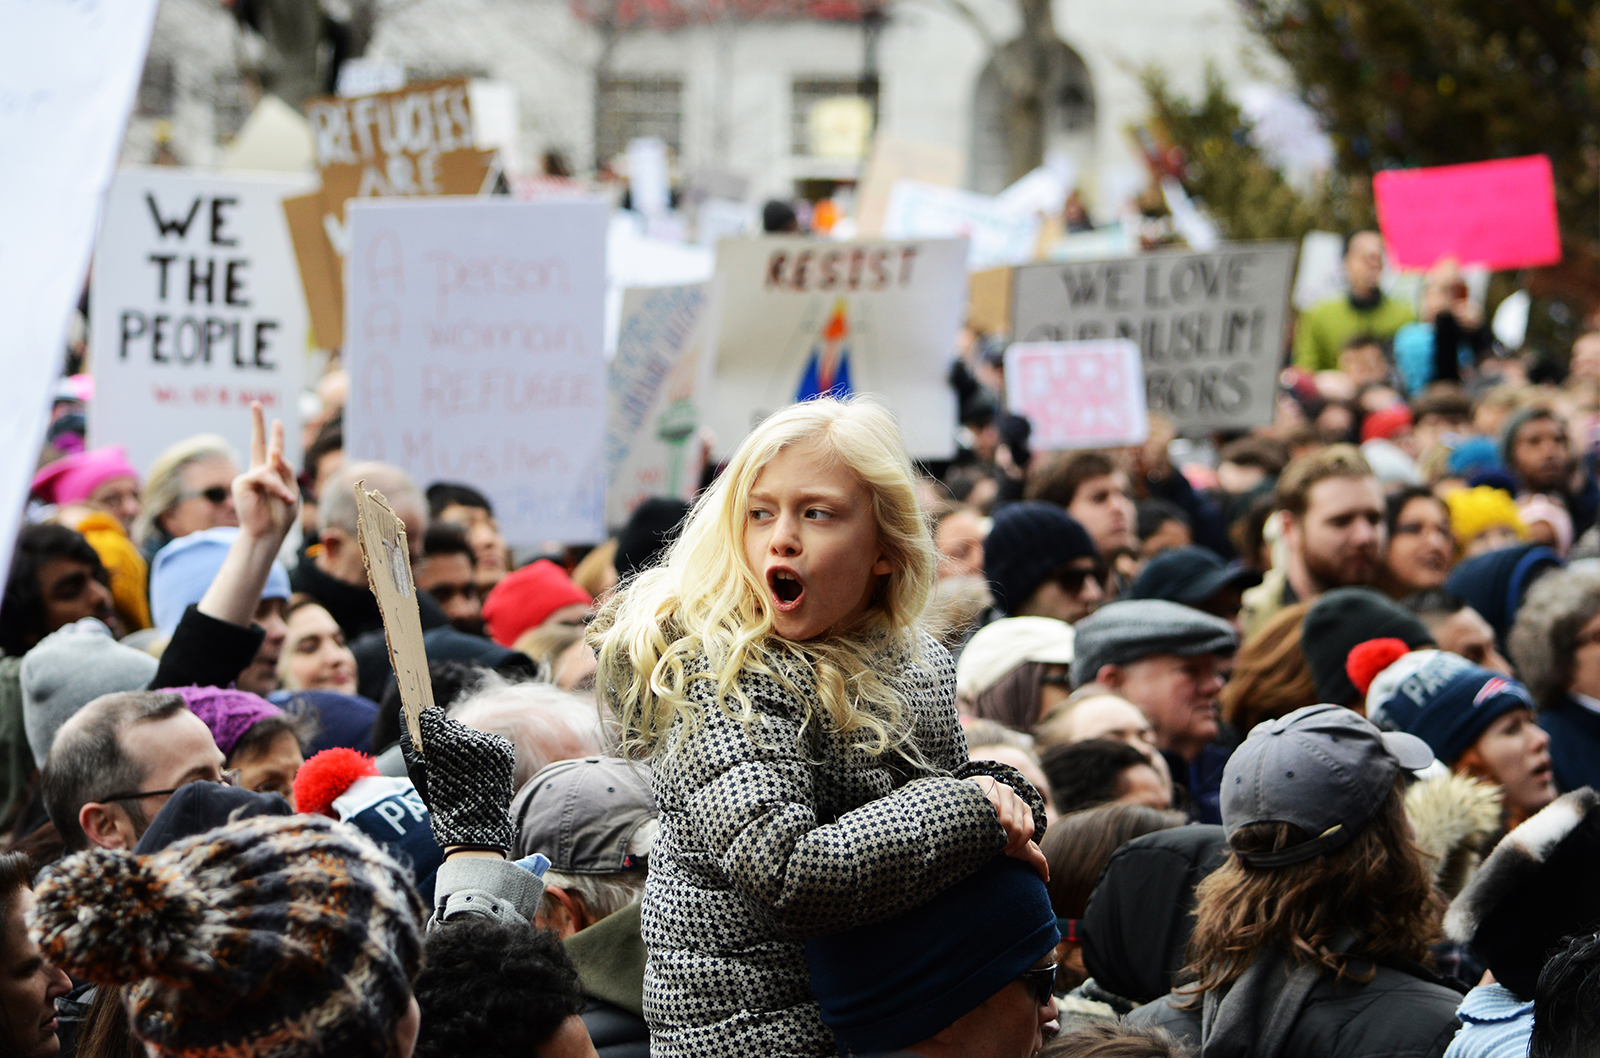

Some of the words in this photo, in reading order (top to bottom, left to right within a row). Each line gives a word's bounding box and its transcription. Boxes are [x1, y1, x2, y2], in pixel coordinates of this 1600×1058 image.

[358, 150, 443, 197] ARE
[145, 192, 238, 246] WE
[147, 254, 250, 306] THE
[364, 227, 405, 297] A
[763, 245, 922, 293] RESIST
[1058, 262, 1137, 311] WE
[1142, 254, 1260, 309] LOVE
[119, 309, 281, 369] PEOPLE
[361, 300, 402, 347] A
[359, 351, 396, 416] A
[356, 426, 386, 461] A
